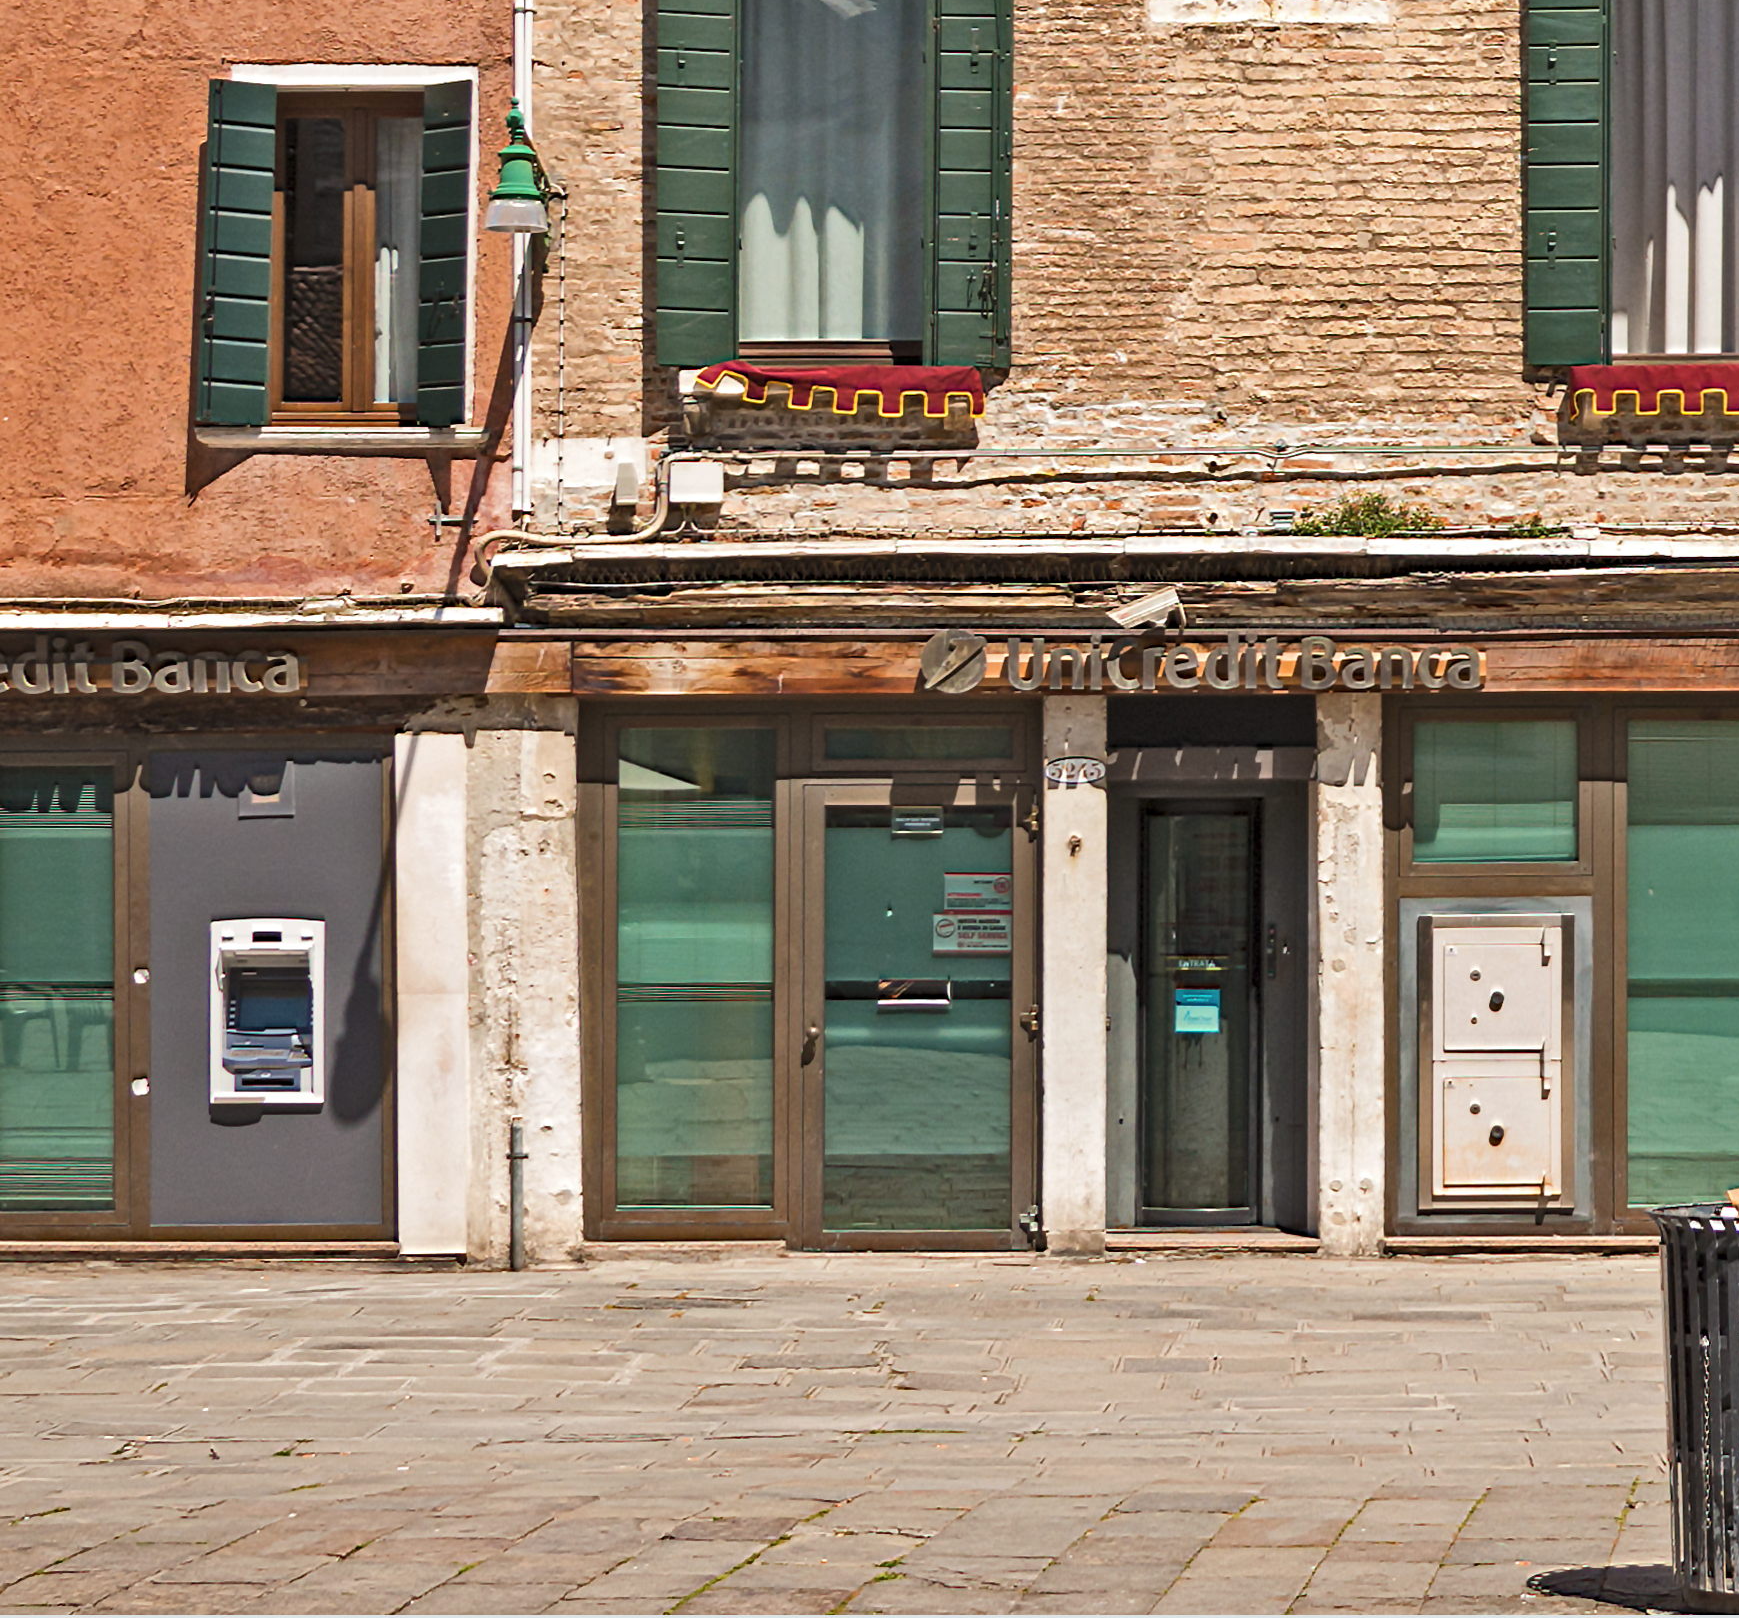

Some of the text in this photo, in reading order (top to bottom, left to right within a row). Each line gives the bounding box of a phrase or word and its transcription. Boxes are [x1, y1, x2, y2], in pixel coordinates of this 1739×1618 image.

[0, 633, 300, 694] dit Banca
[1006, 630, 1483, 691] UniCredit Banca
